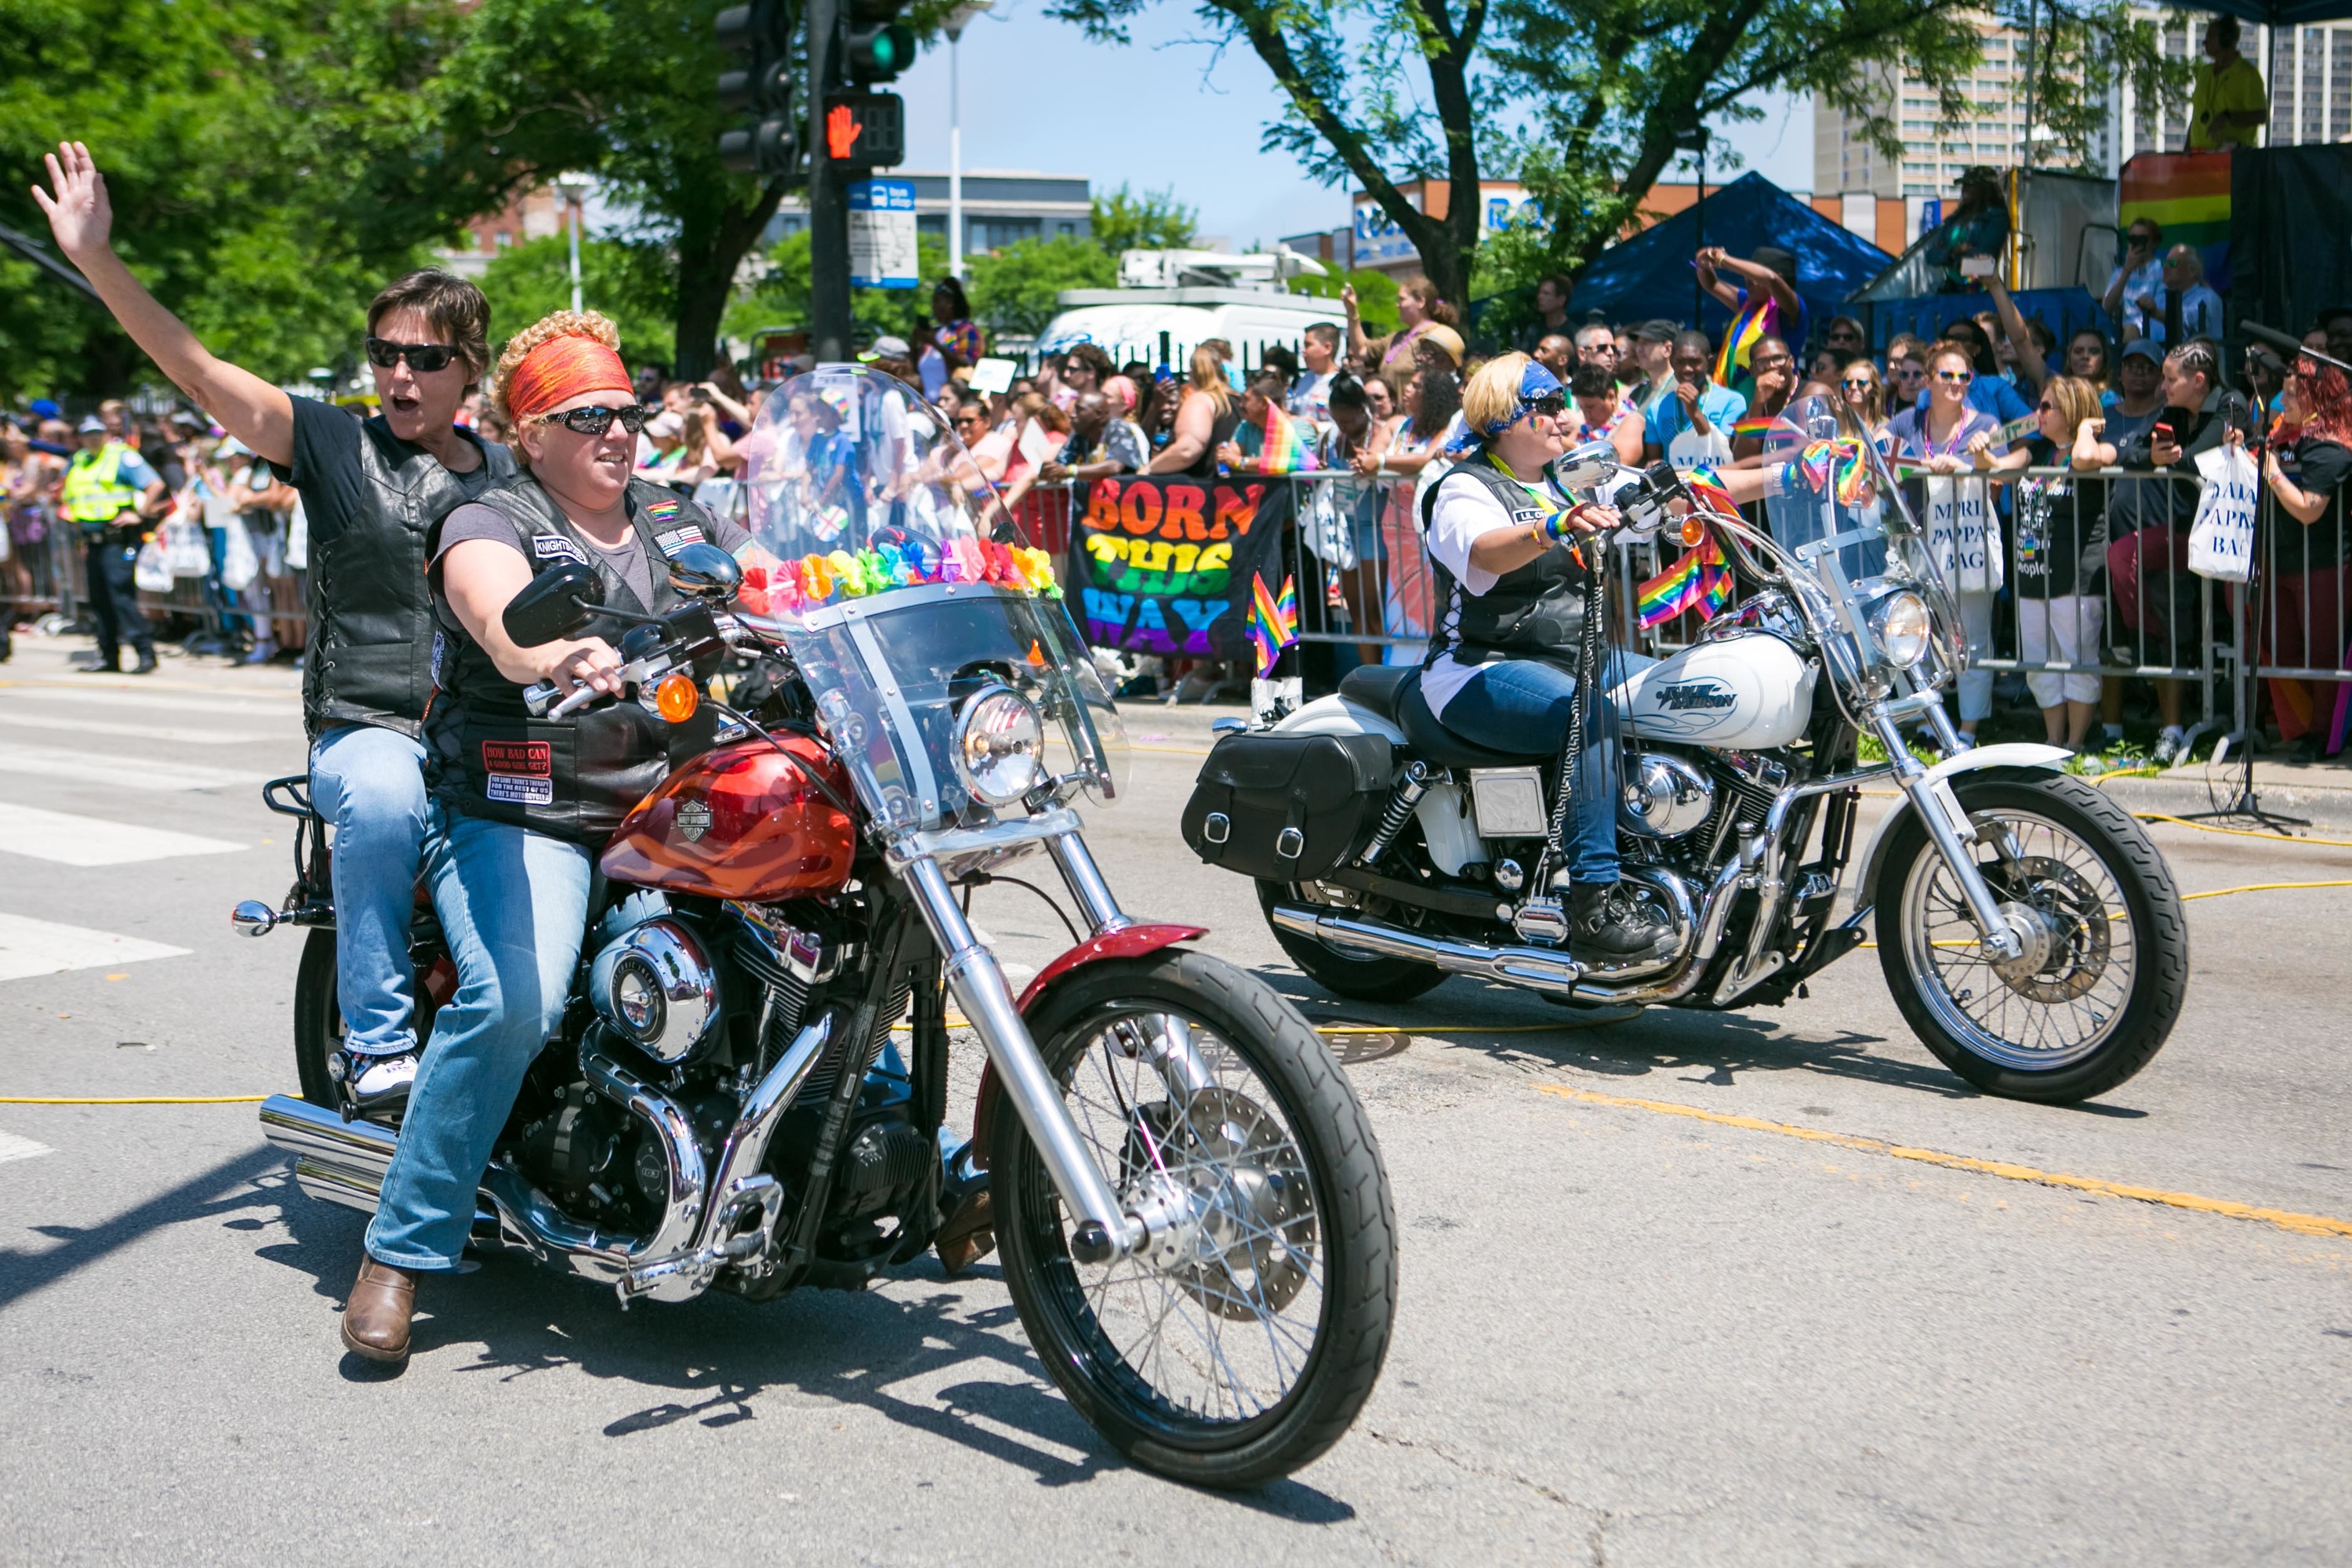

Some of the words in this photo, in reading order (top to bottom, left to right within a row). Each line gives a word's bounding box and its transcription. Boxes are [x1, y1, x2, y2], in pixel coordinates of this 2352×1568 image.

[1080, 477, 1266, 541] BORN
[1520, 511, 1534, 521] LIL
[1534, 510, 1549, 519] ON
[1086, 532, 1232, 596] THIS
[1081, 587, 1230, 654] WAY
[487, 747, 505, 758] HOW
[508, 749, 525, 759] BAD
[528, 749, 546, 760] CAN
[528, 762, 546, 771] GET?
[510, 791, 549, 801] MOTORCYCLES
[642, 1167, 659, 1178] 103
